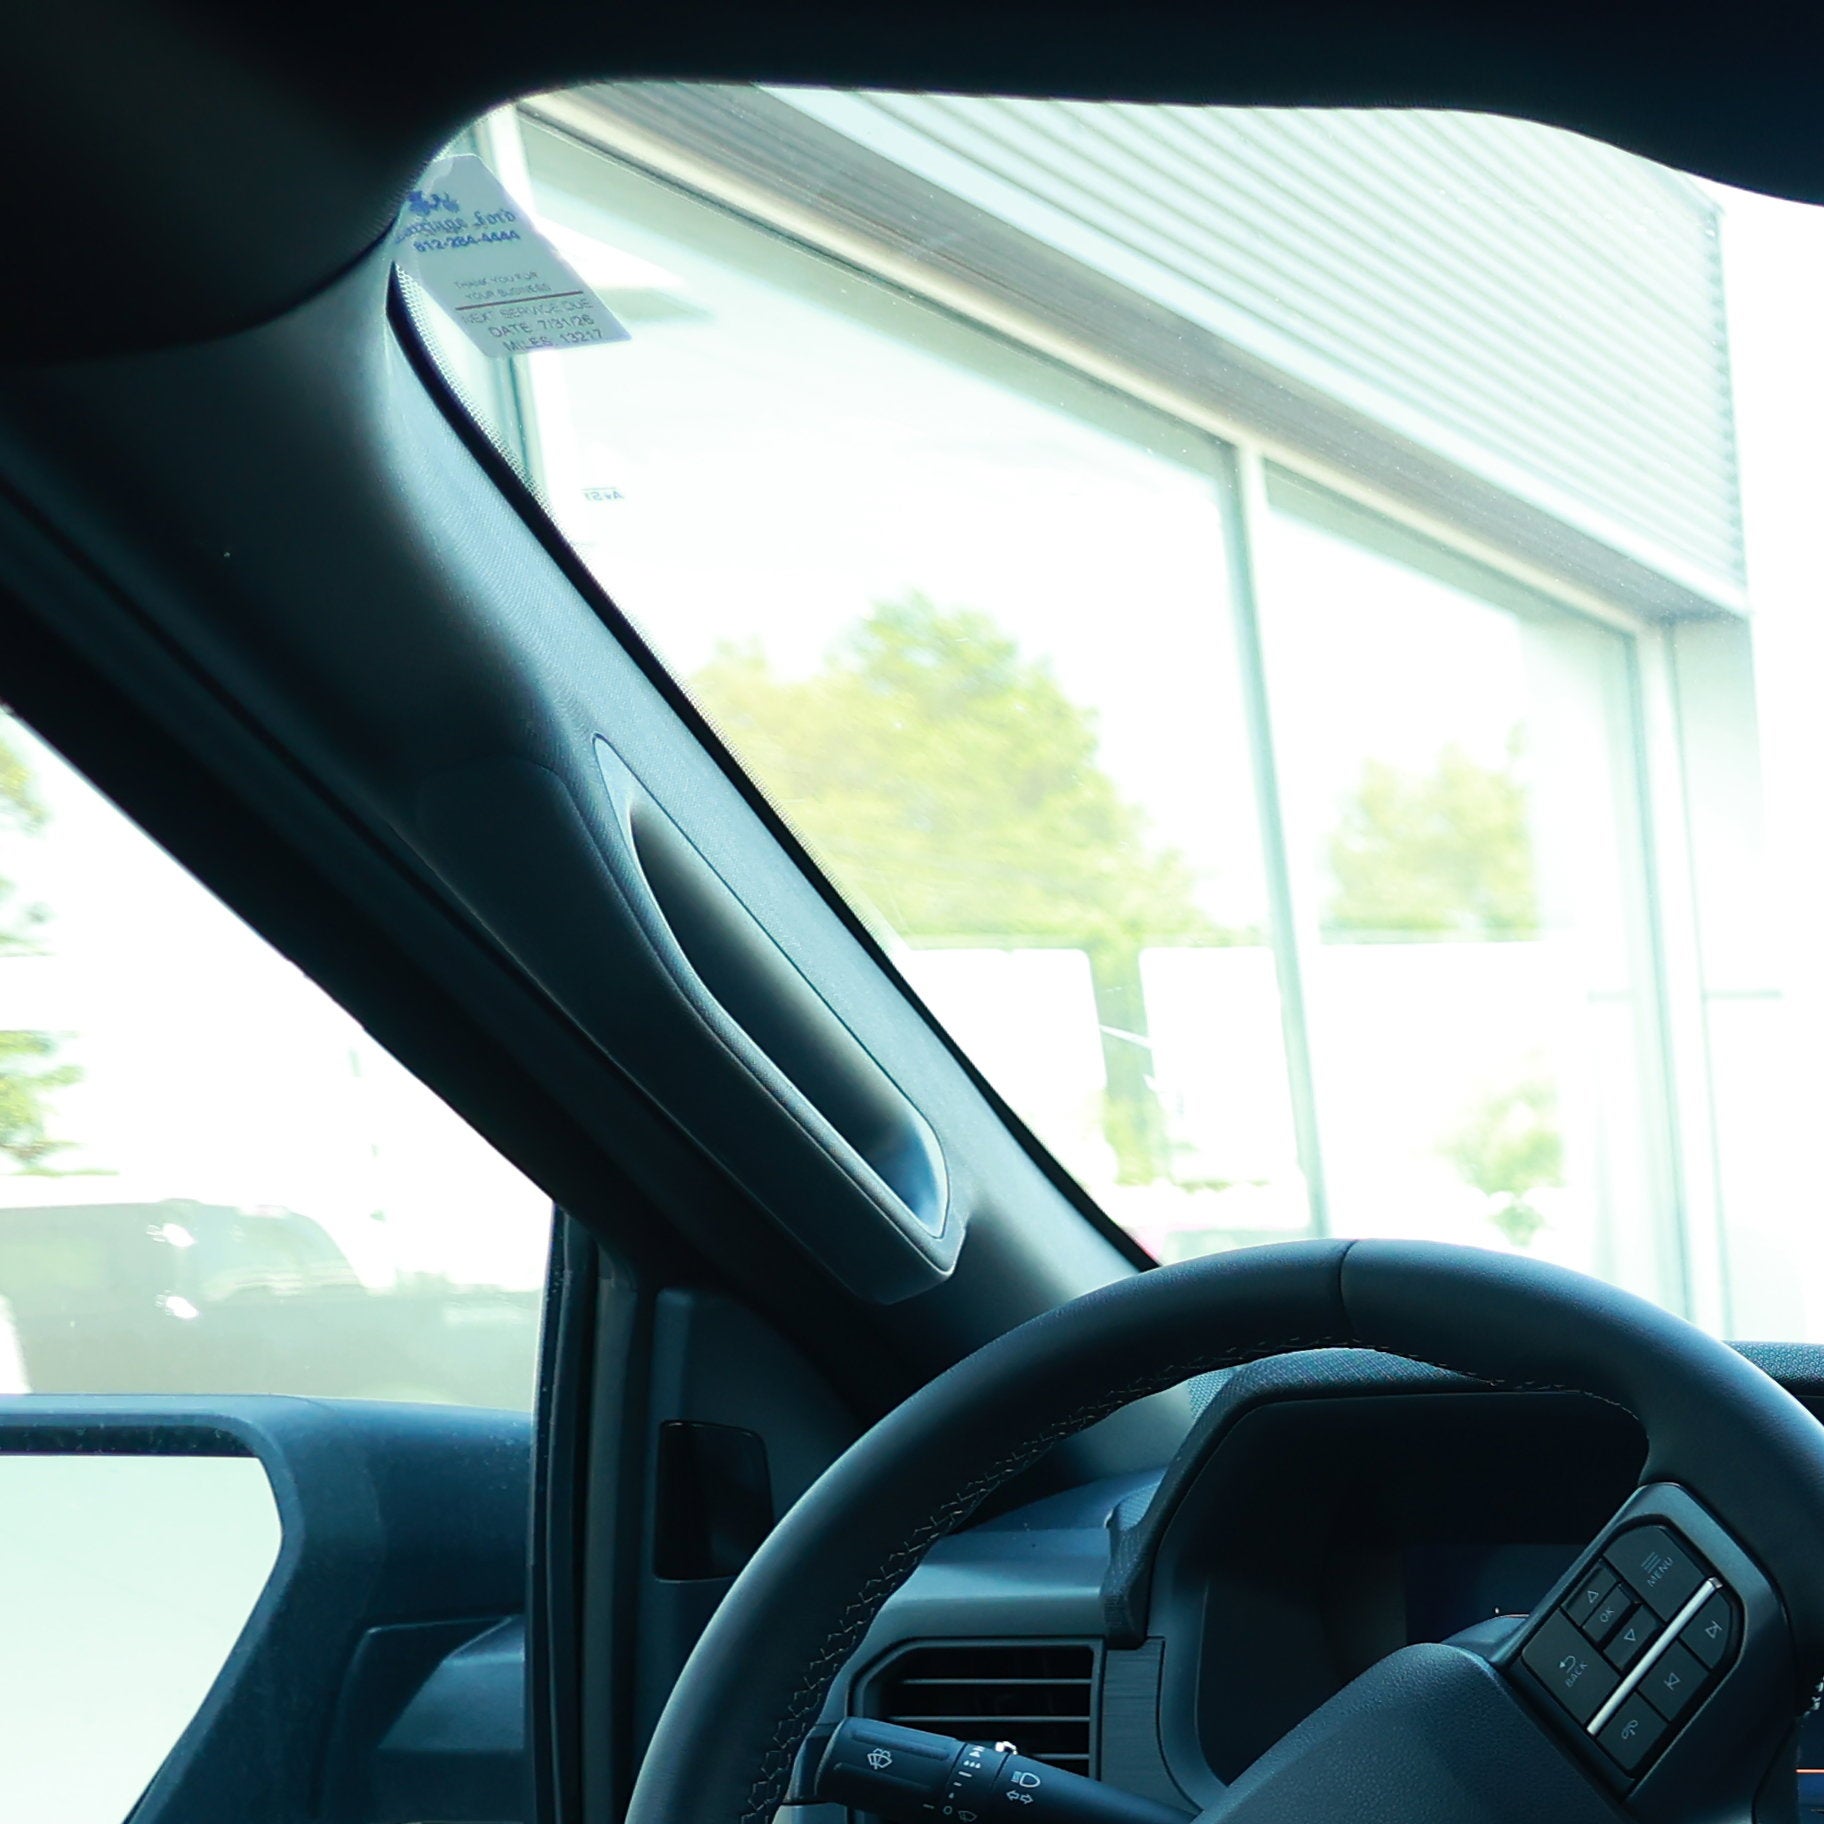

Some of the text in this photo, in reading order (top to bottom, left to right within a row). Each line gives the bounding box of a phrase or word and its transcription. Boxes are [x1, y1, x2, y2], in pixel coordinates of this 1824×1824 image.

[500, 302, 562, 319] SERVICE
[563, 297, 594, 312] DUE
[487, 322, 534, 338] DATE
[1647, 1556, 1673, 1587] MENU
[1600, 1607, 1615, 1623] OK
[1564, 1662, 1589, 1689] BACK
